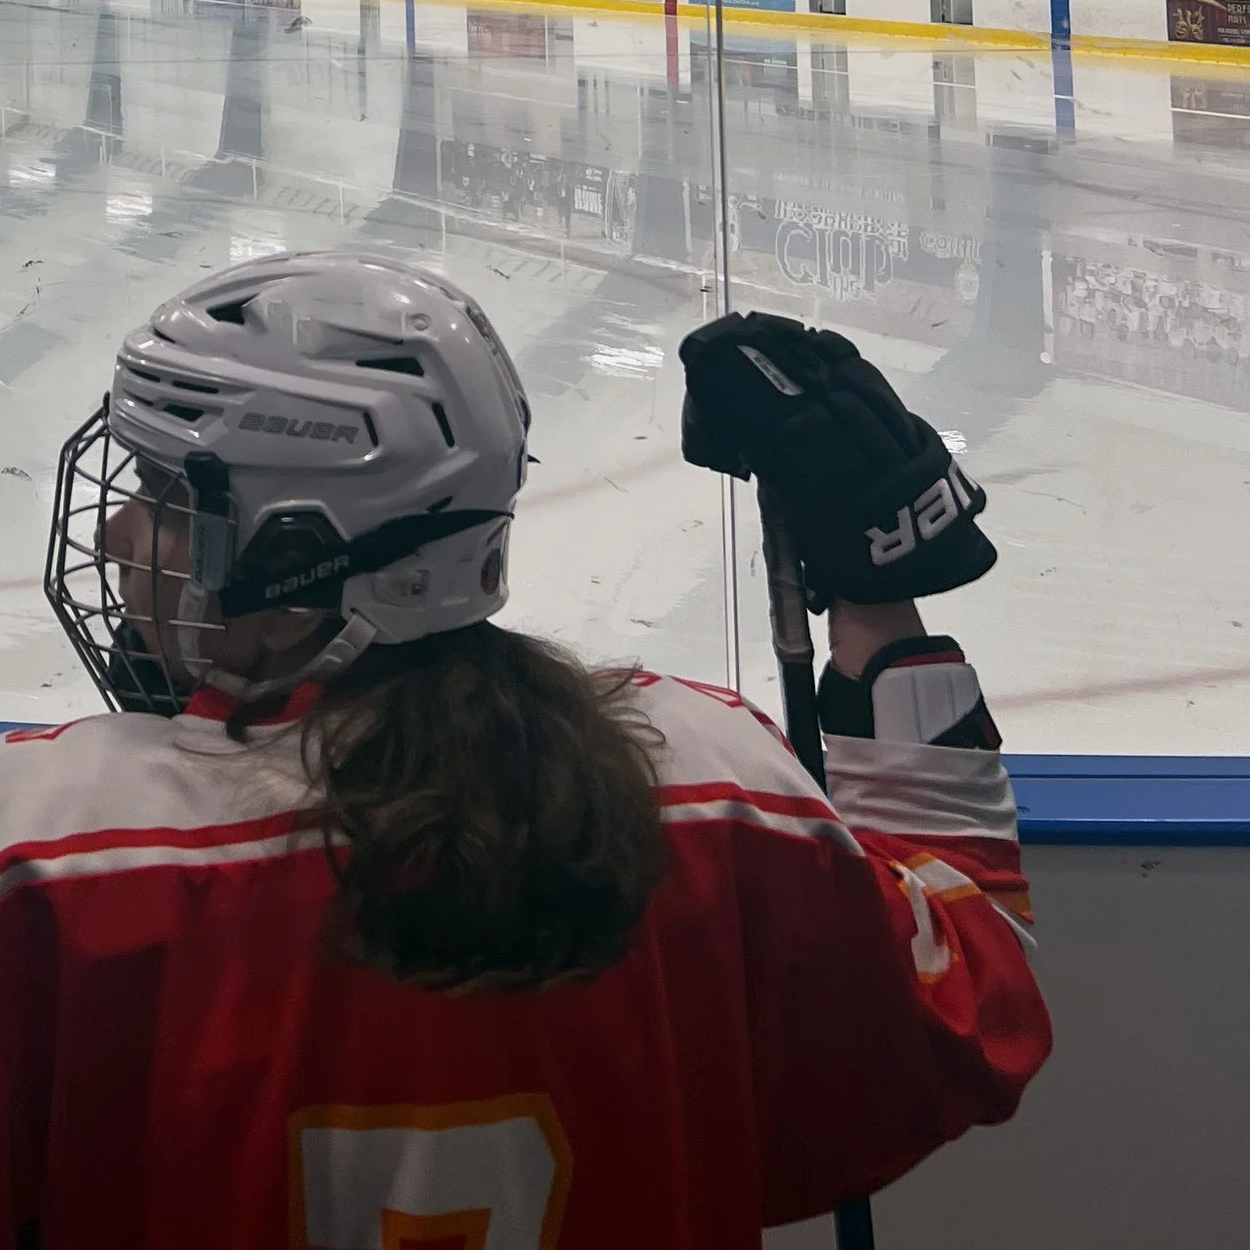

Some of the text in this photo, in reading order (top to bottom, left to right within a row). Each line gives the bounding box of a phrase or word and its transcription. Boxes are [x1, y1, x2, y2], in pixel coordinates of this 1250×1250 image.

[238, 411, 359, 444] BAUER
[862, 458, 980, 567] UER
[265, 554, 350, 599] BAUER
